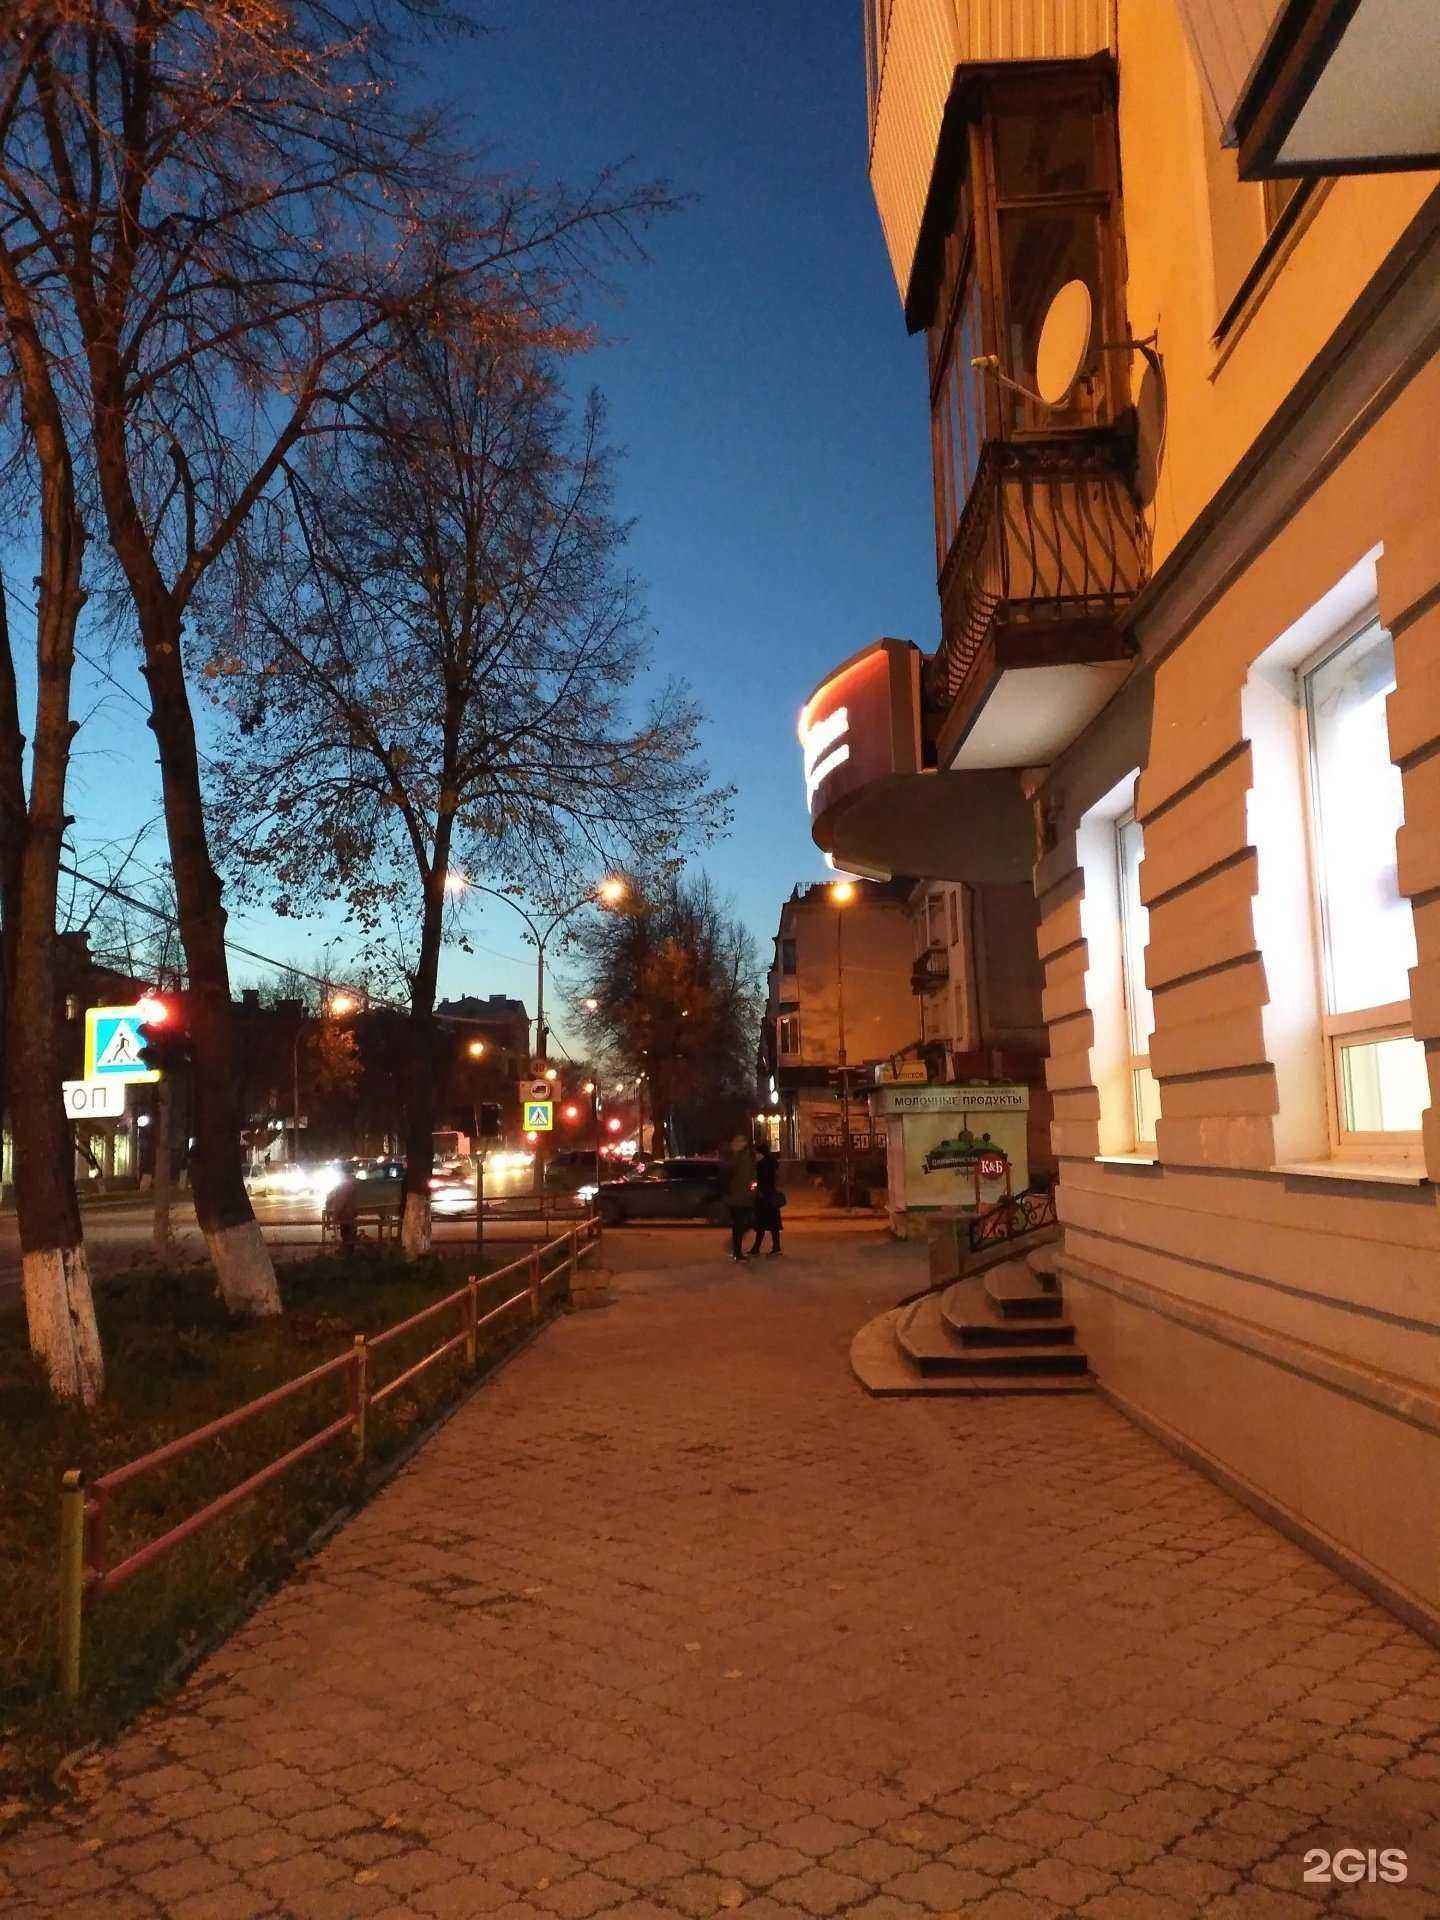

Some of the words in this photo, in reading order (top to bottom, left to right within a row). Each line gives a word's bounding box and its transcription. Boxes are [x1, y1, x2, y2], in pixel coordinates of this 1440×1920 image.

[64, 1087, 107, 1110] ОП
[894, 1095, 958, 1107] МОЛОЧНЫЕ
[962, 1095, 1024, 1107] ПРОДУКТЫ
